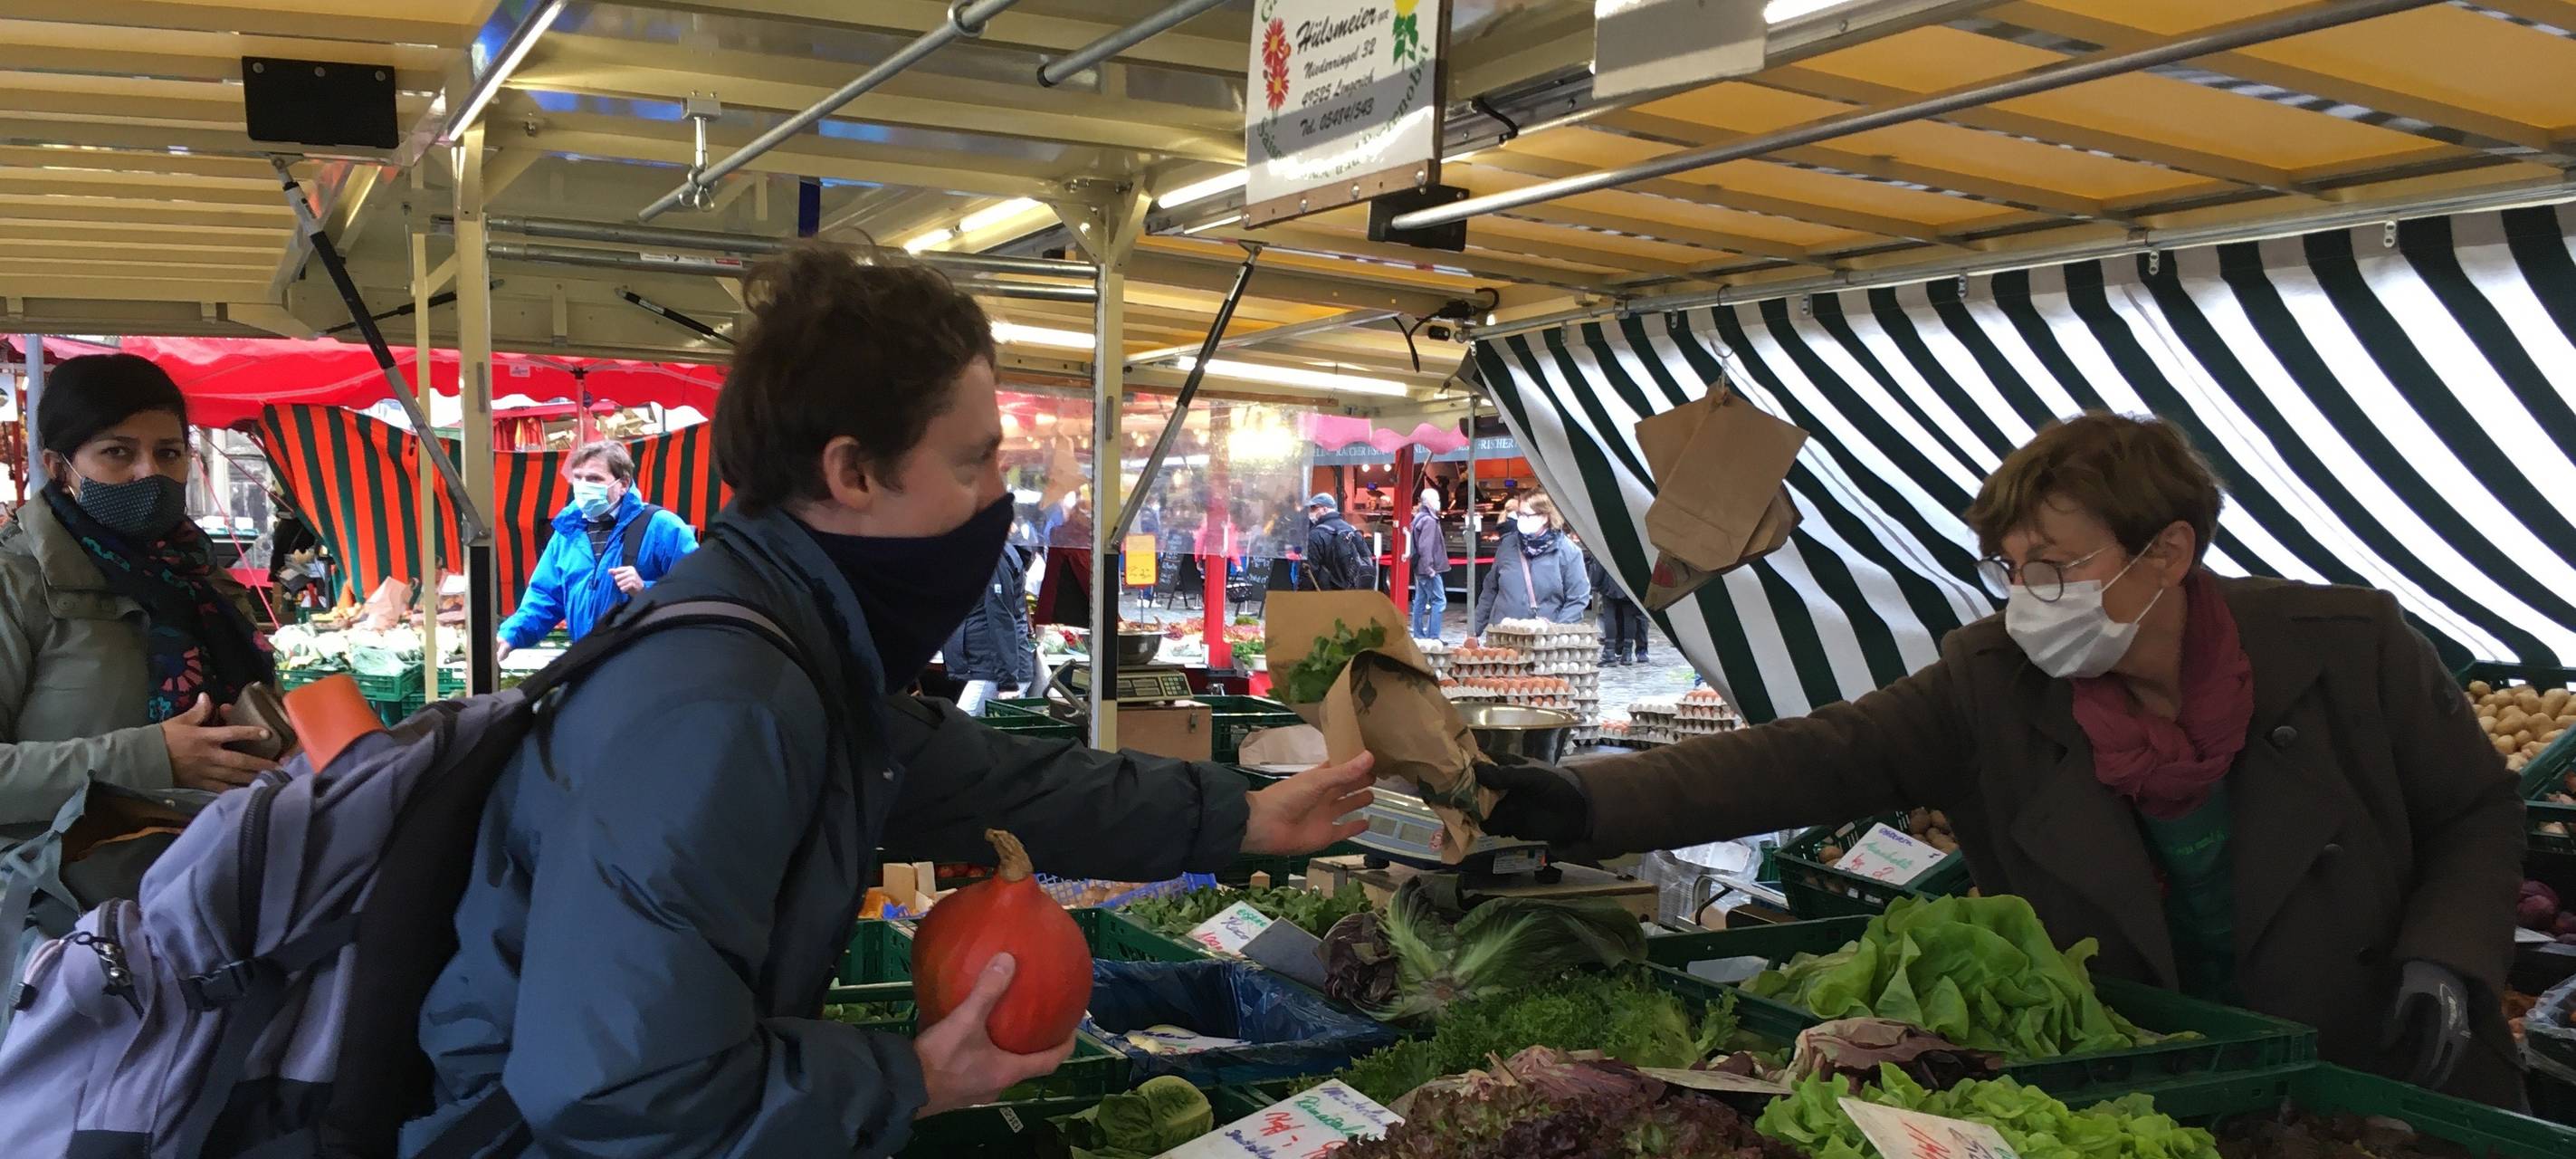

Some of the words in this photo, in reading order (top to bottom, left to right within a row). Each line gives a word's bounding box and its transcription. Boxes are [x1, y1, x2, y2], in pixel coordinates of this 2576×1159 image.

[1296, 7, 1377, 54] Hülsmeier
[1361, 37, 1377, 58] 32
[1302, 83, 1331, 108] 49525
[1300, 117, 1316, 137] Tel.
